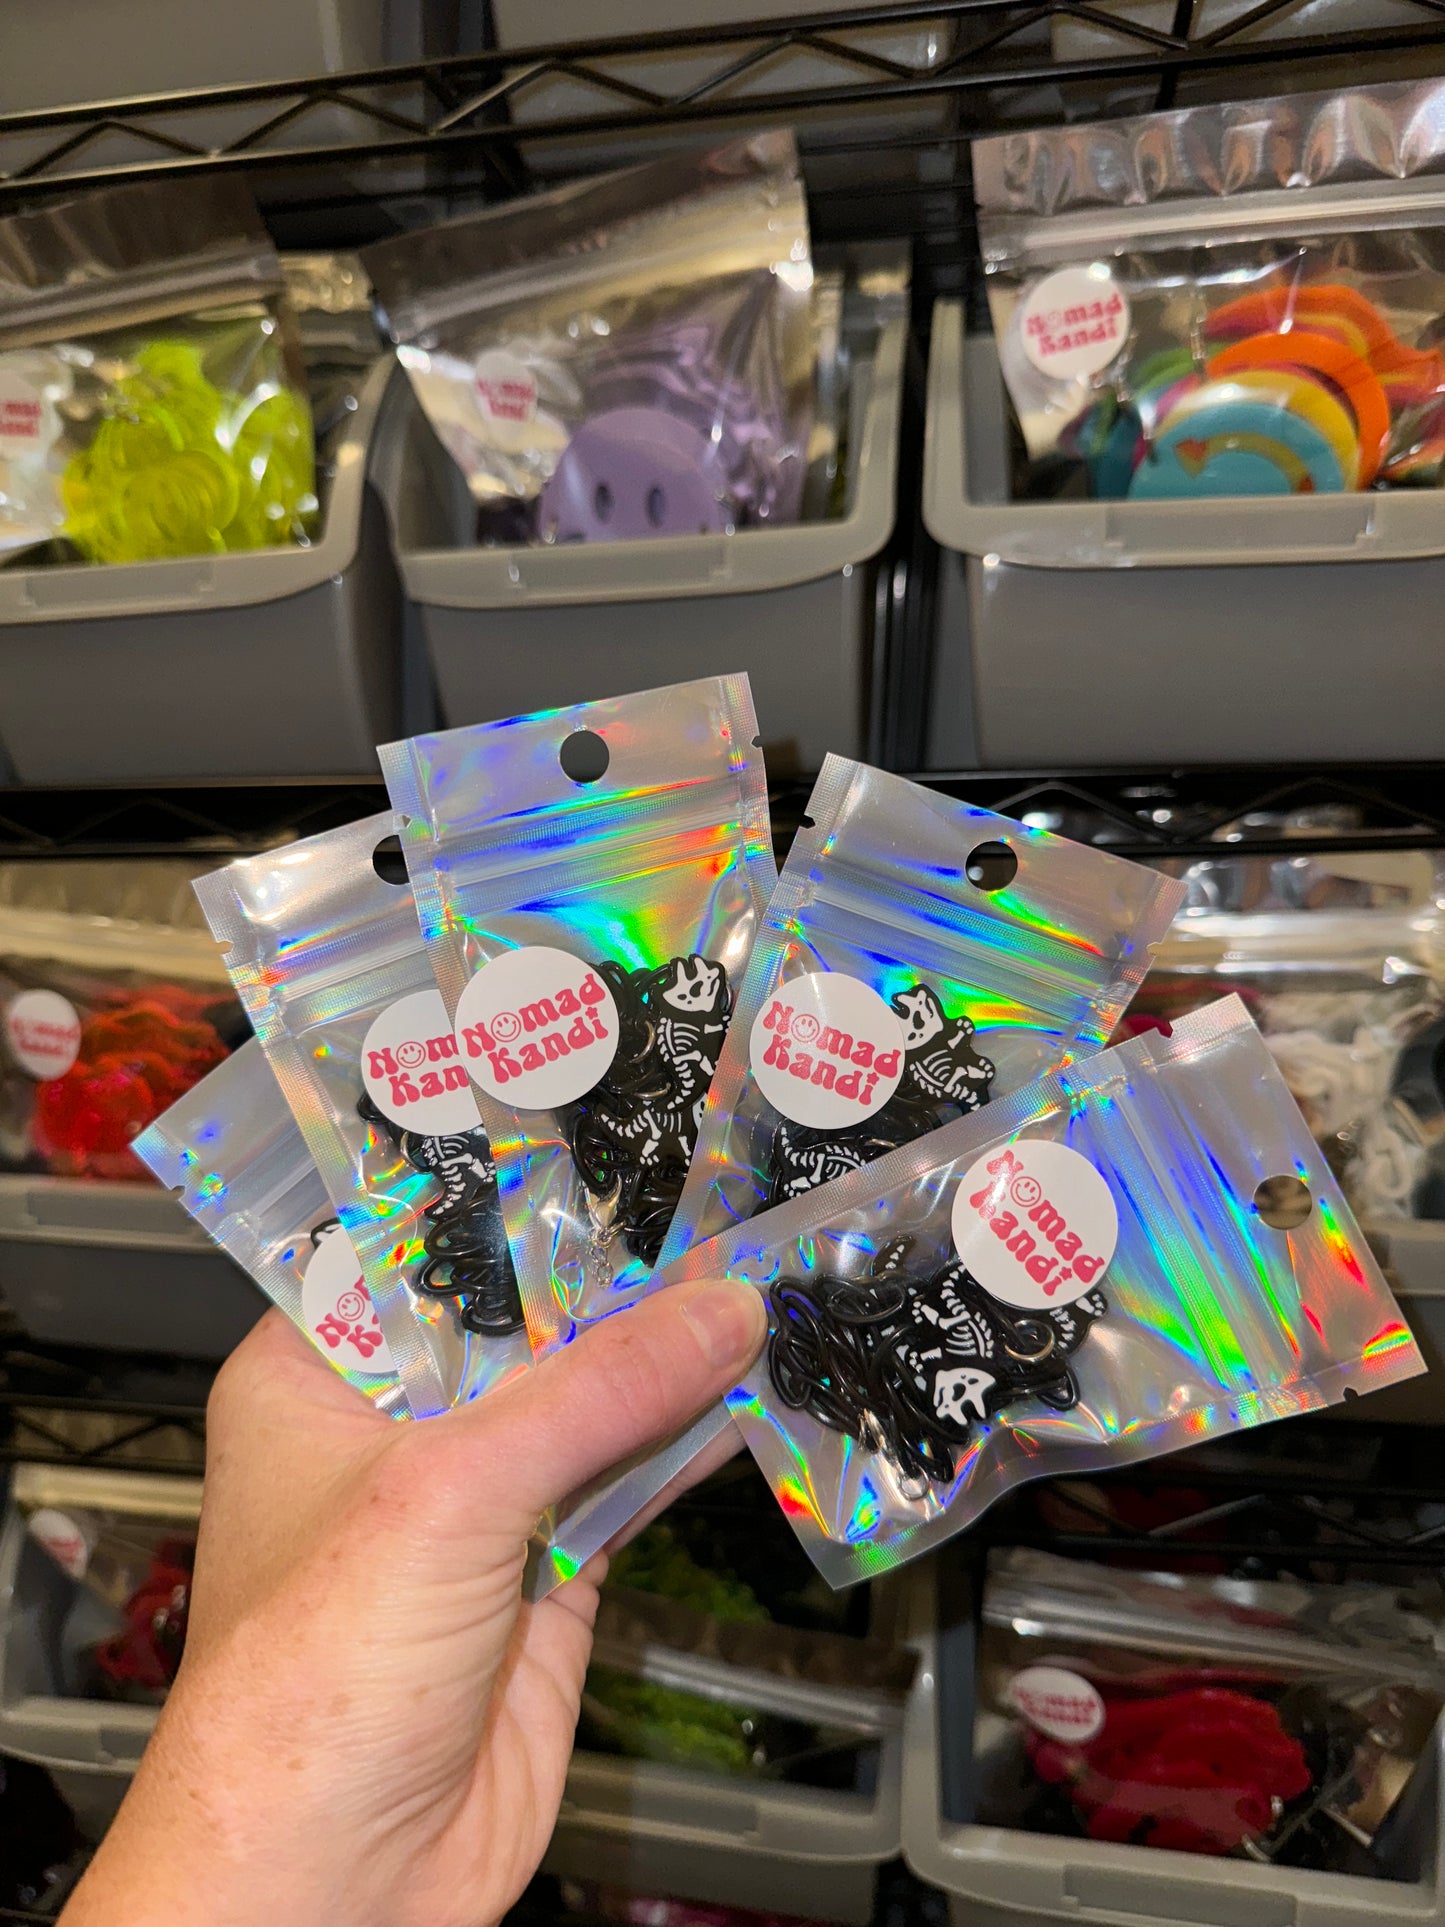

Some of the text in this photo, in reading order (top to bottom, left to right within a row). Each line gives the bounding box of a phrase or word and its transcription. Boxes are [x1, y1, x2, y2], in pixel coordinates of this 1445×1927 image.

[461, 973, 606, 1058] Nomad
[487, 1006, 609, 1085] Kandi
[762, 1000, 902, 1079] Nomad
[367, 1033, 458, 1080] Nom
[388, 1064, 470, 1107] Kan
[763, 1034, 880, 1106] Kandi
